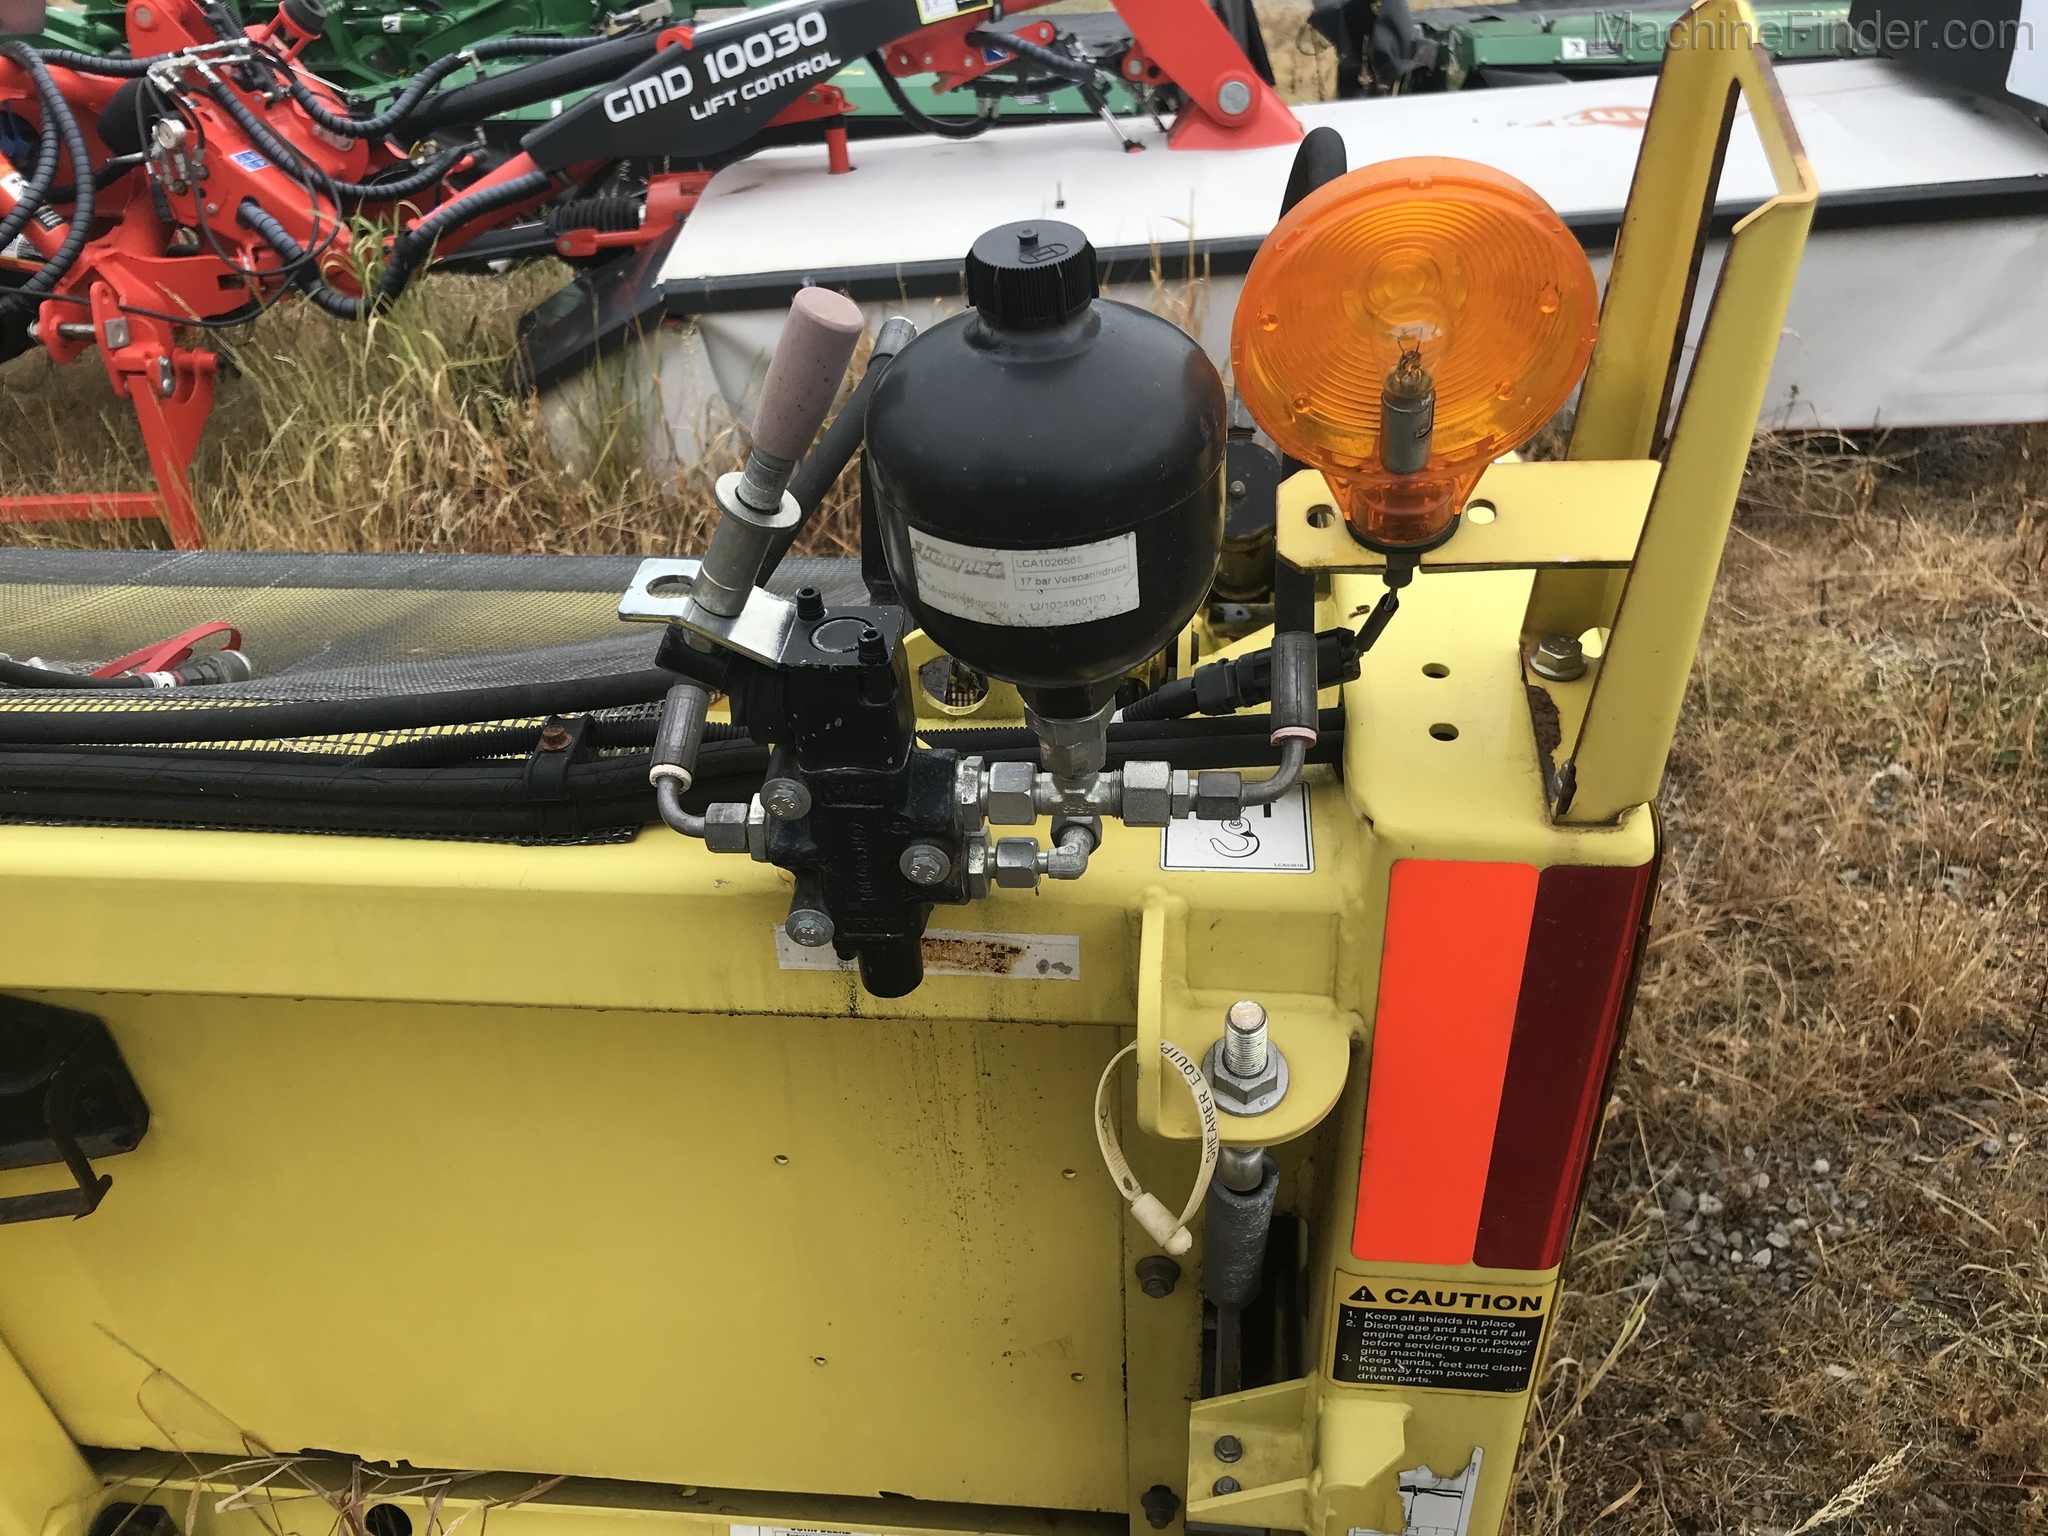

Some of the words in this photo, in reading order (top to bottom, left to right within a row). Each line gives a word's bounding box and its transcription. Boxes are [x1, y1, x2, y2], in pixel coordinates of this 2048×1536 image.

[603, 65, 694, 123] GMD
[703, 11, 828, 84] 10030
[689, 88, 738, 121] LIFT
[741, 51, 842, 101] CONTROL
[1021, 577, 1031, 586] 17
[1035, 577, 1051, 586] bar
[1054, 564, 1128, 584] Vorspanndruck
[1160, 1042, 1202, 1086] EQUIP
[1199, 1090, 1217, 1163] SHEARER
[1385, 1288, 1542, 1311] CAUTION
[1365, 1312, 1397, 1321] Keep
[1400, 1314, 1414, 1322] all
[1419, 1314, 1462, 1325] shields
[1467, 1318, 1477, 1326] in
[1481, 1318, 1515, 1328] place
[1364, 1321, 1429, 1333] Disengage
[1433, 1324, 1456, 1333] and
[1460, 1325, 1487, 1335] shut
[1491, 1327, 1507, 1337] off
[1511, 1329, 1526, 1337] all
[1363, 1330, 1404, 1339] engine
[1407, 1332, 1449, 1342] and/or
[1452, 1335, 1490, 1344] motor
[1493, 1337, 1532, 1347] power
[1361, 1339, 1401, 1348] before
[1405, 1341, 1460, 1353] servicing
[1481, 1346, 1527, 1356] unclog-
[1361, 1348, 1387, 1357] ging
[1391, 1349, 1445, 1359] machine.
[1342, 1354, 1352, 1362] 3.
[1359, 1356, 1391, 1366] Keep
[1395, 1357, 1435, 1368] hands,
[1466, 1362, 1488, 1370] and
[1492, 1364, 1527, 1372] cloth-
[1358, 1364, 1377, 1373] ing
[1380, 1366, 1412, 1375] away
[1415, 1367, 1443, 1375] from
[1446, 1370, 1490, 1379] power-
[1357, 1372, 1394, 1381] driven
[1397, 1375, 1432, 1384] parts.
